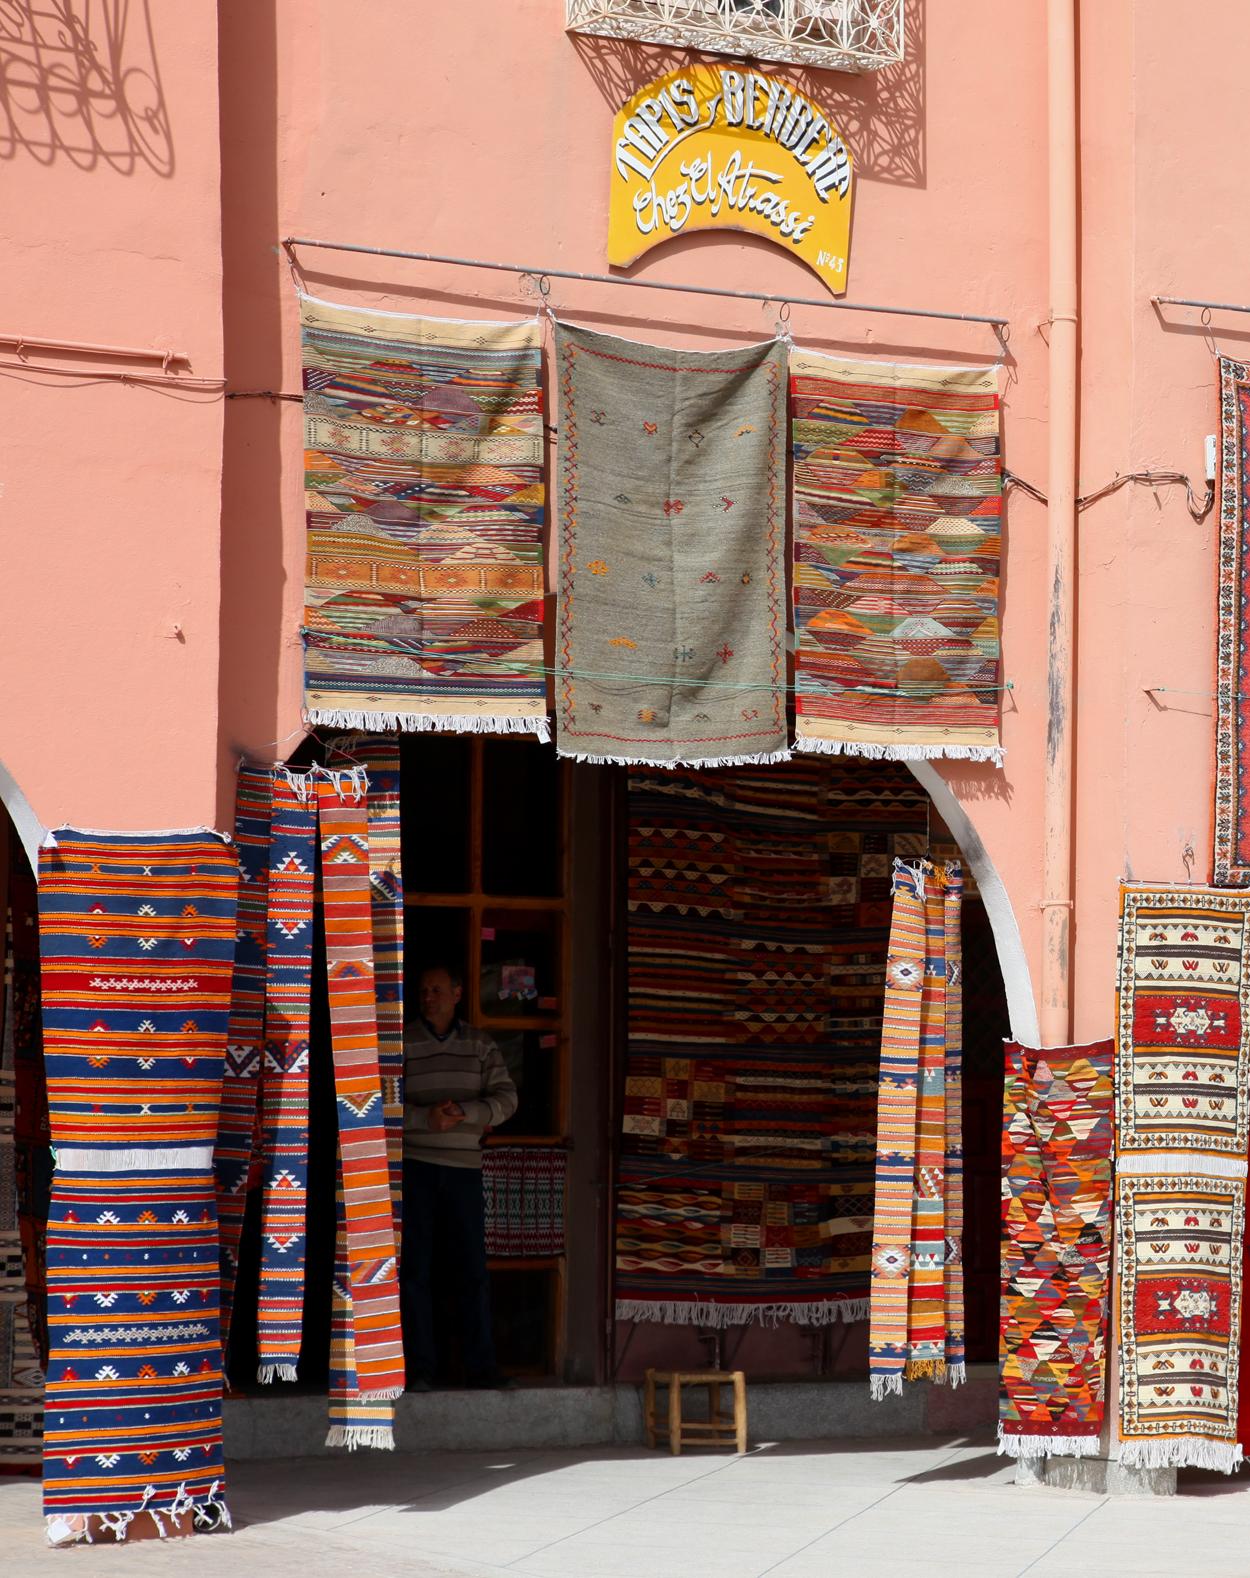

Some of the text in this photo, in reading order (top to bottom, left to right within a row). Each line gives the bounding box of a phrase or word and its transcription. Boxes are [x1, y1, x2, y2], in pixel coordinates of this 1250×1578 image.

[615, 70, 850, 203] TAPIS BERBERE
[632, 180, 691, 233] Chez
[681, 151, 717, 202] El
